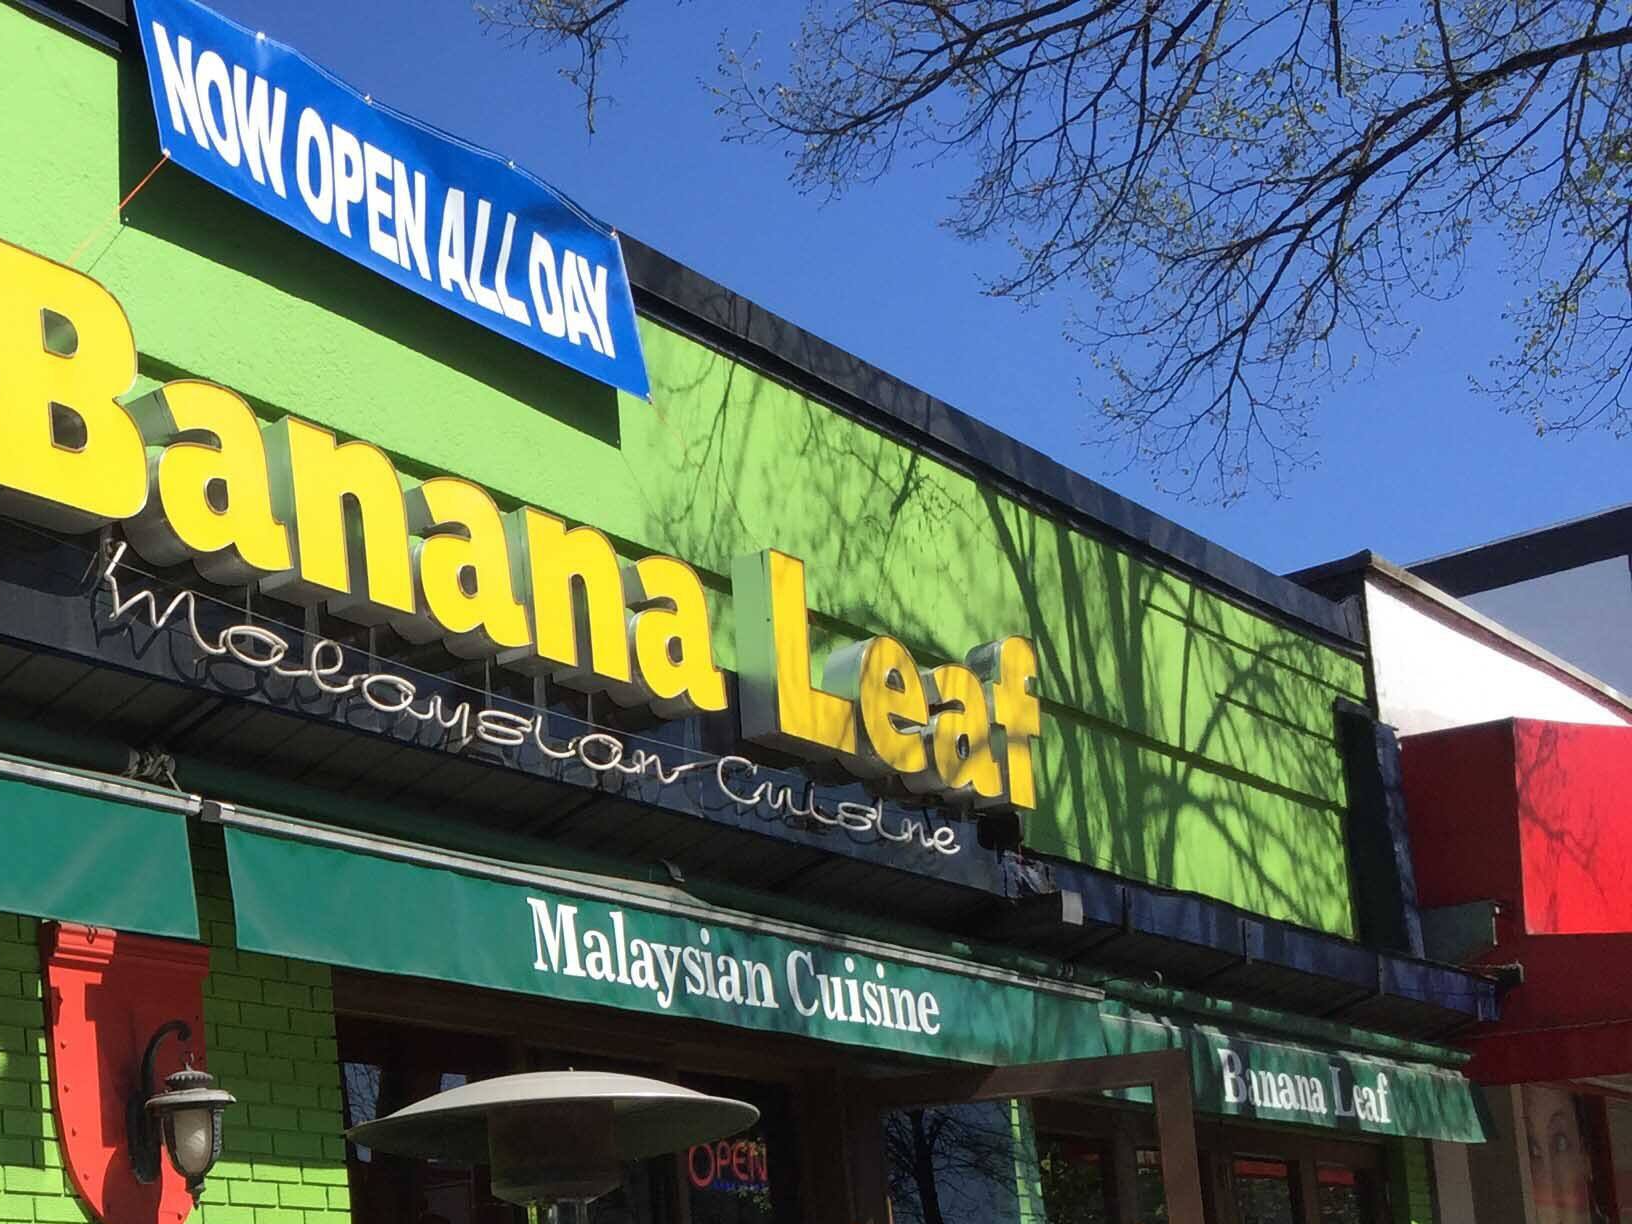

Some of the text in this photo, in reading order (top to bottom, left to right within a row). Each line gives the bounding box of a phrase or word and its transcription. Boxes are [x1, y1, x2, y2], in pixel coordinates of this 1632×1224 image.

[152, 21, 616, 360] NOW OPEN ALL DAY
[103, 541, 961, 857] Malaysian Cuisine
[762, 547, 1041, 812] Leaf
[525, 896, 942, 1036] Malaysian Cuisine
[687, 1139, 769, 1189] OPEN
[1217, 1047, 1391, 1124] Banana Leaf
